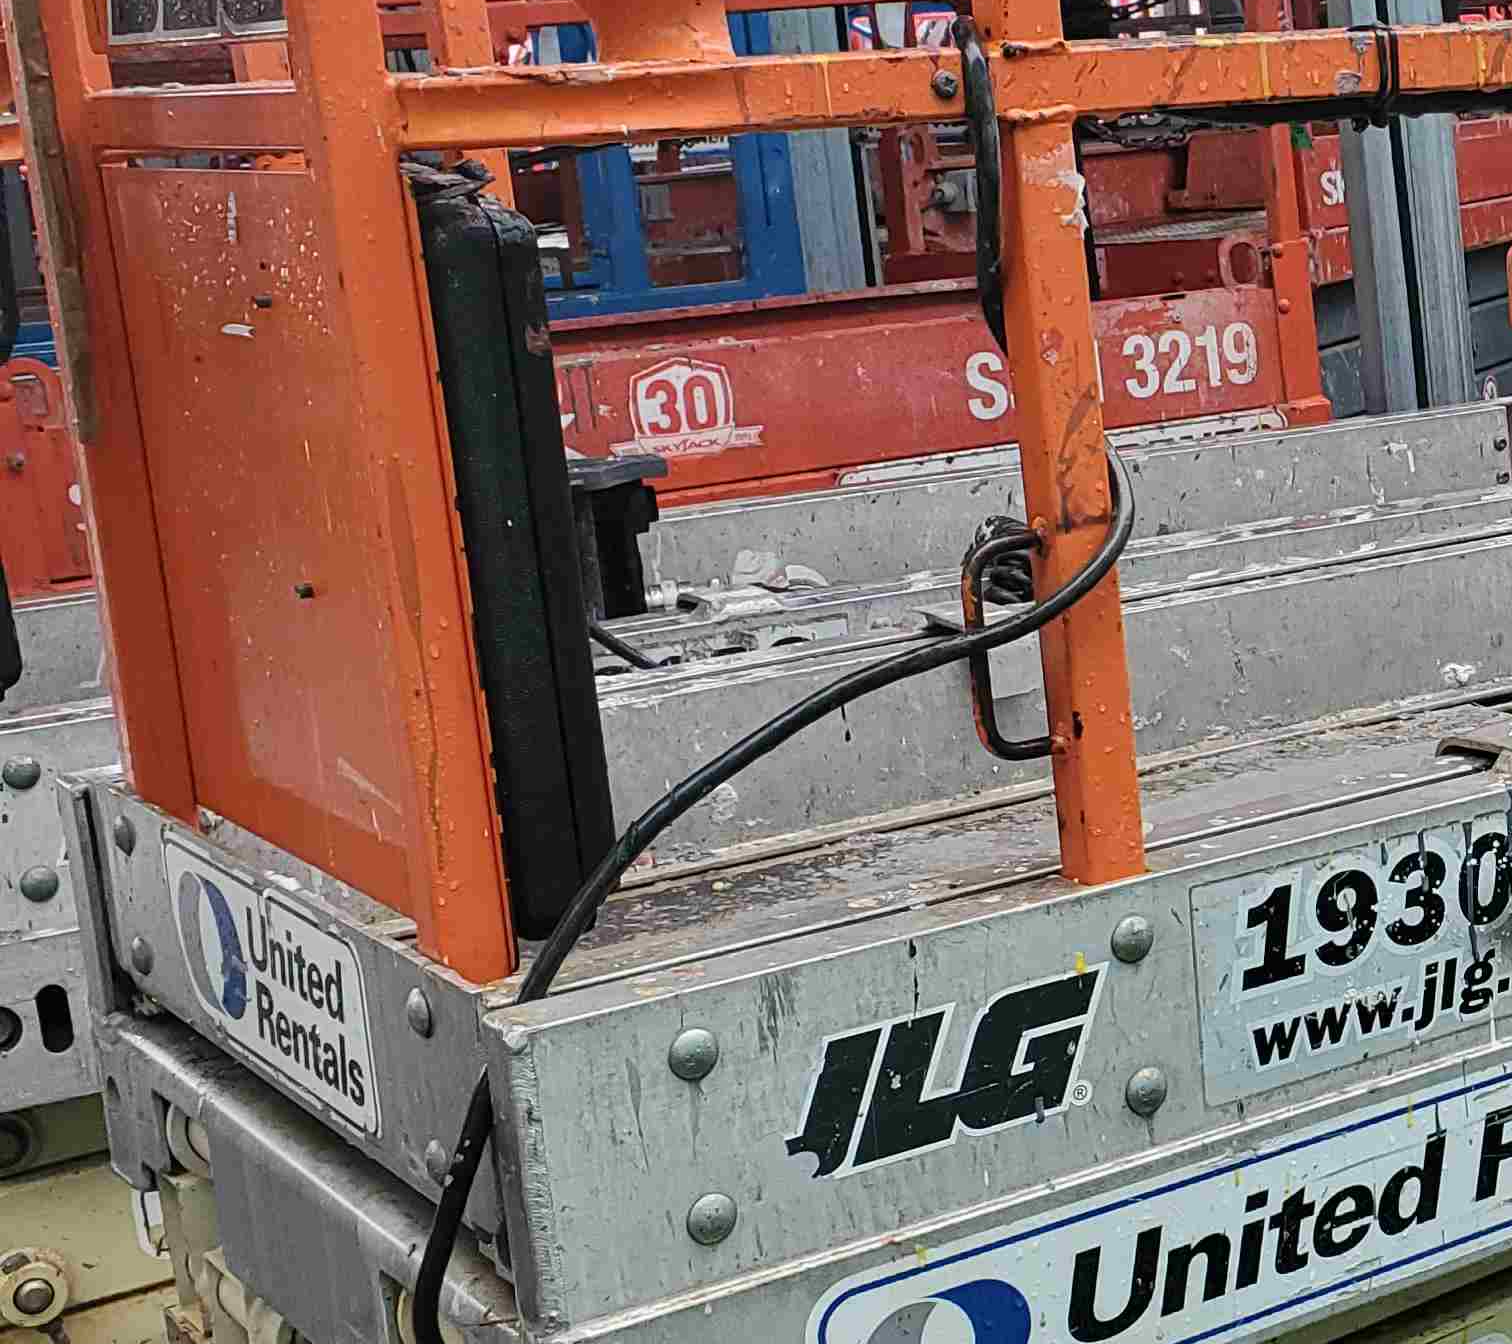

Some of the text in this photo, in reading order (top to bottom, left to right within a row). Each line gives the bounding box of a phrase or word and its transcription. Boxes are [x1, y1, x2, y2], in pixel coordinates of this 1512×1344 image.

[645, 375, 718, 435] 30
[1122, 322, 1258, 399] 3219
[246, 906, 345, 1025] United
[256, 979, 365, 1106] Rentals
[785, 966, 1104, 1178] JLG
[1066, 1126, 1447, 1344] United
